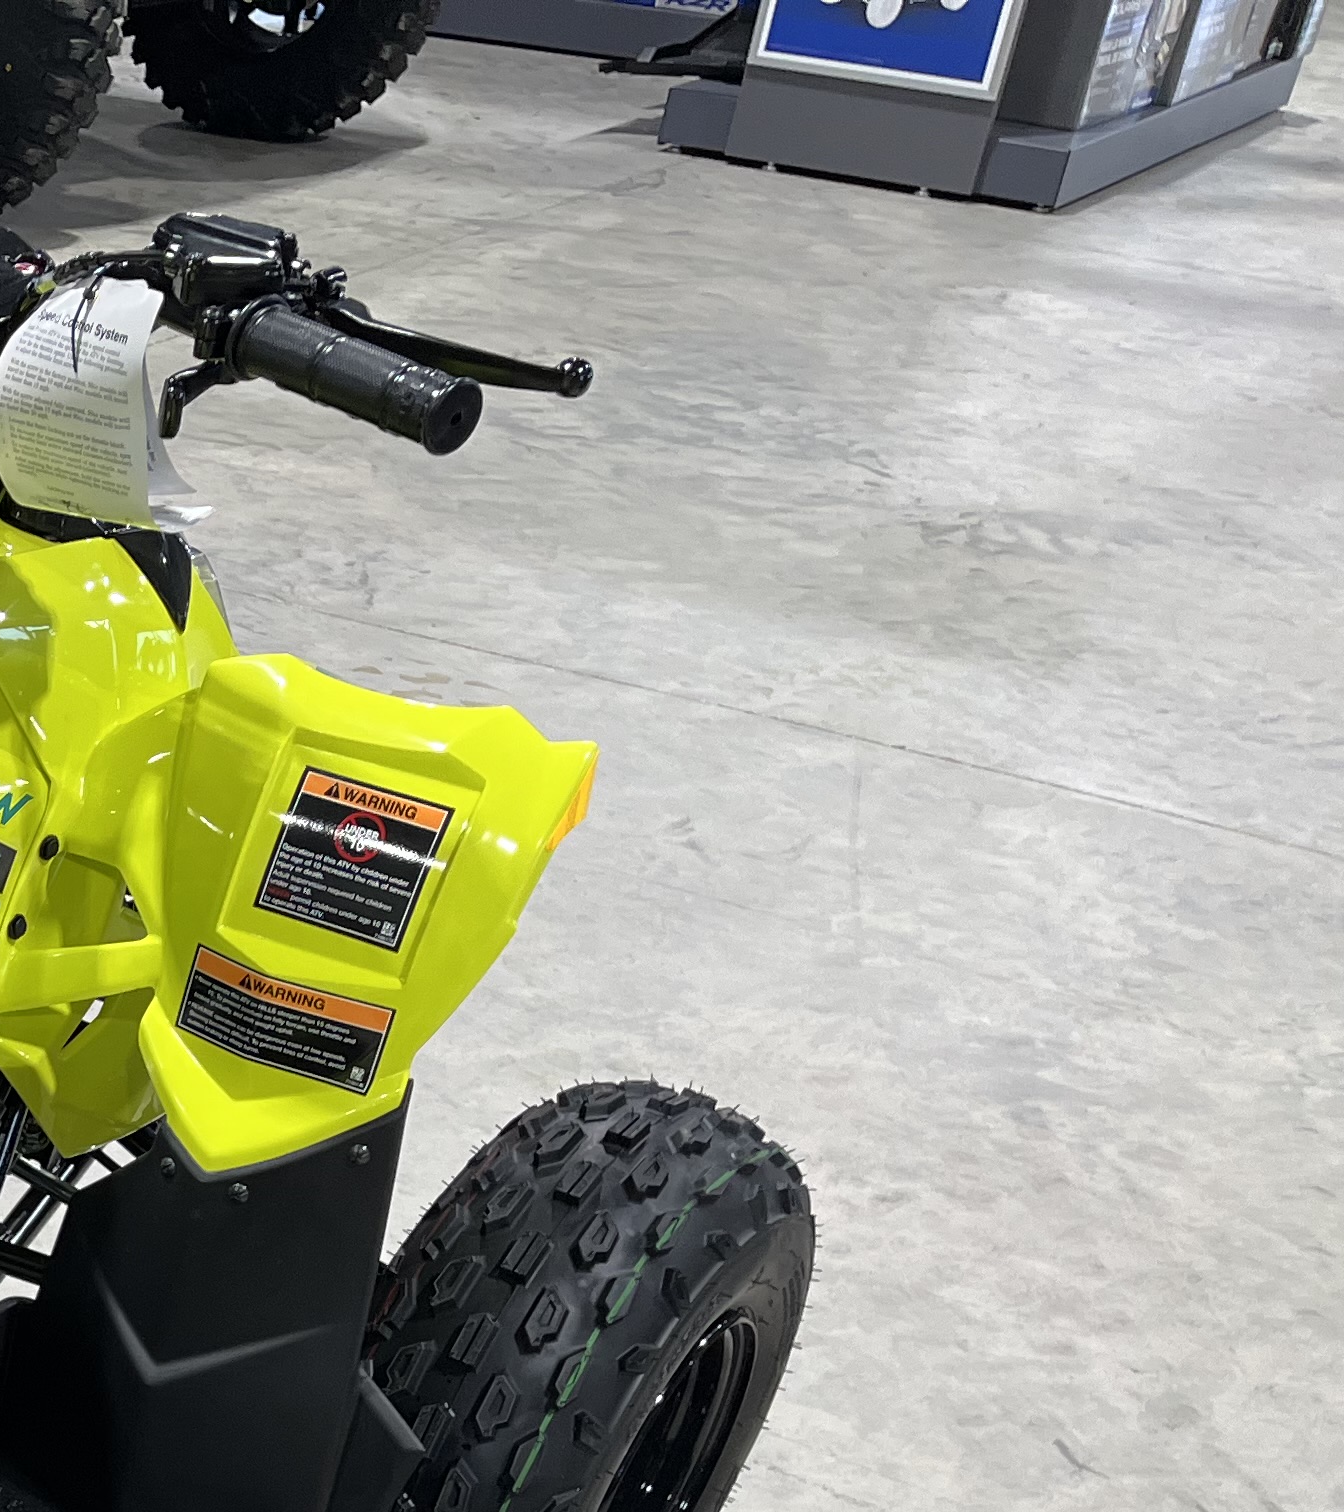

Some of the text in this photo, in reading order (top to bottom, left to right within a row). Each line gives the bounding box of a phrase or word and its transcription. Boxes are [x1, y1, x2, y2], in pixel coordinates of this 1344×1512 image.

[94, 323, 129, 345] System
[342, 787, 418, 821] WARNING
[345, 823, 380, 842] UNDER
[253, 977, 325, 1011] WARNING
